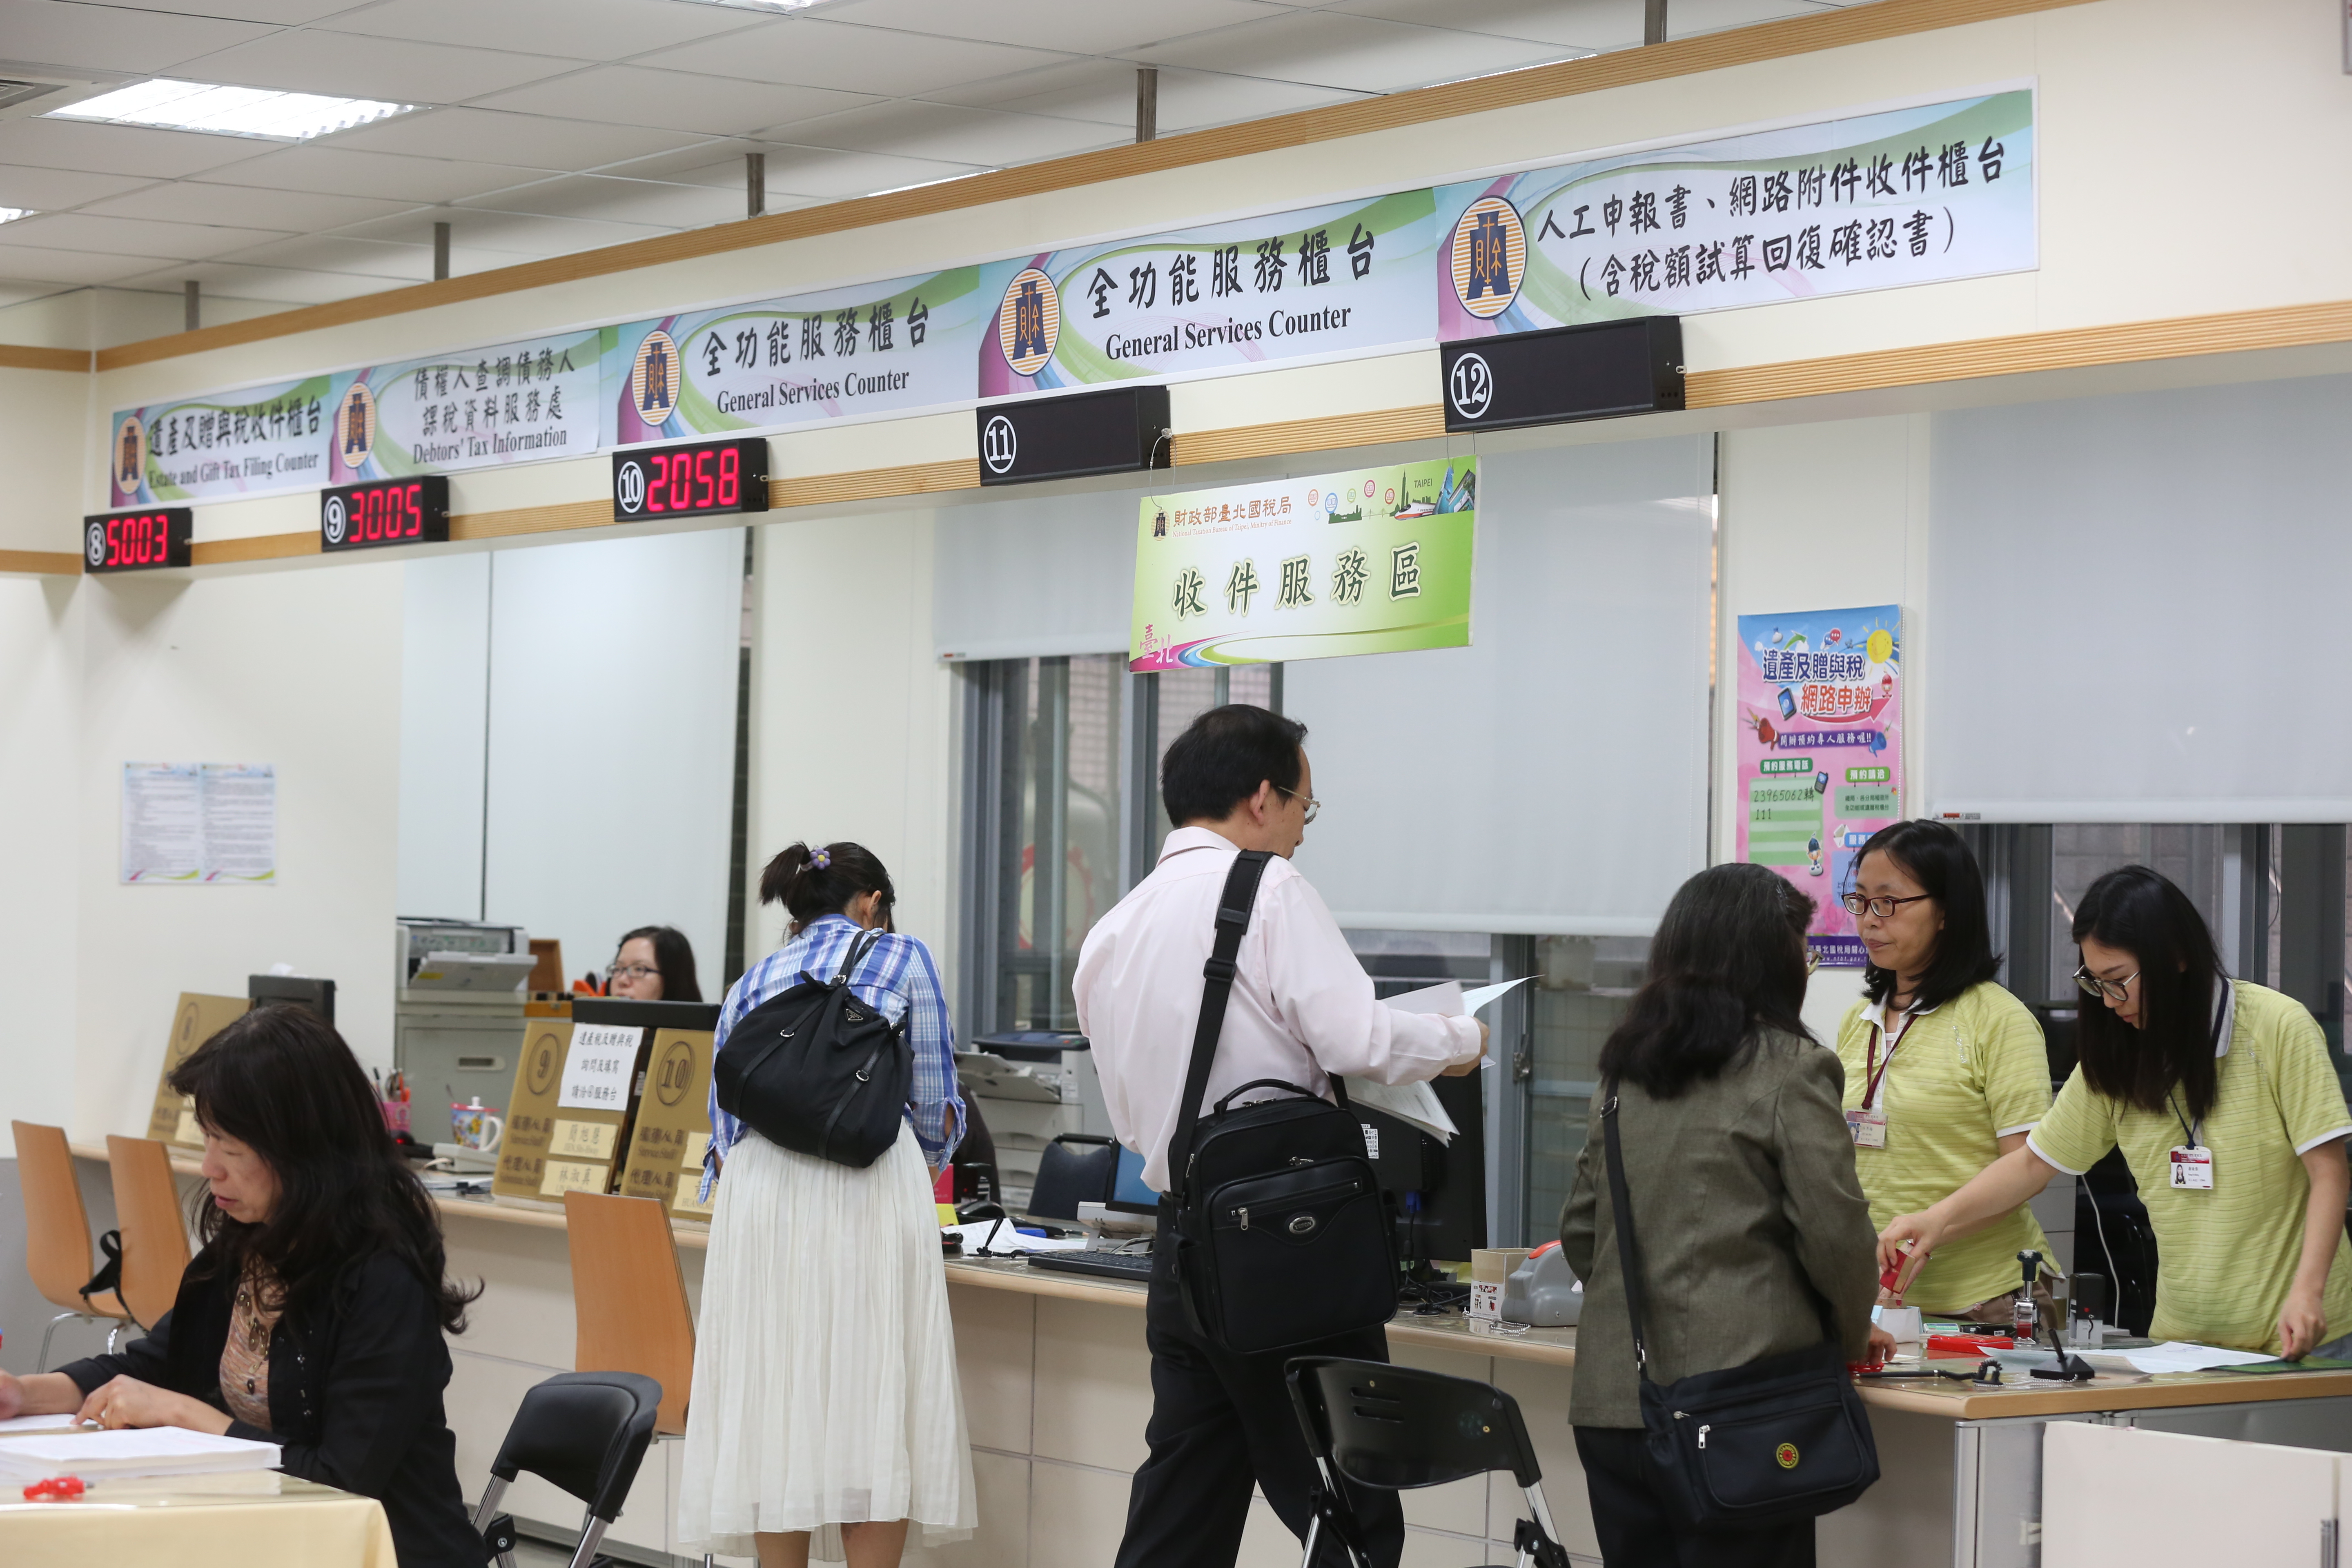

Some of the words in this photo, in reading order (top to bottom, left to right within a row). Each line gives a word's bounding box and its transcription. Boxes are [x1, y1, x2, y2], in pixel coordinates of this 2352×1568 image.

[1537, 136, 2005, 243] 人工申報書、網路附件收件櫃台
[1087, 222, 1375, 319] 全功能服務櫃台
[702, 296, 929, 376] 全功能服務櫃台
[1106, 325, 1178, 361] General
[1184, 316, 1262, 350] Services
[1268, 305, 1351, 338] Counter
[414, 348, 575, 401] 債權人查調債務人
[717, 384, 775, 414] General
[779, 378, 840, 406] Services
[845, 369, 909, 397] Counter
[1456, 364, 1489, 408] 12
[149, 394, 321, 457] 遺產及贈與稅收件櫃台
[423, 385, 563, 437] 課稅資料服務處
[413, 439, 464, 464] Debtors'
[468, 437, 488, 456] Tax
[493, 429, 567, 453] Information
[989, 424, 1011, 462] 11
[149, 468, 176, 488] Estate
[180, 468, 198, 484] and
[200, 458, 220, 483] Gift
[224, 460, 240, 479] Tax
[244, 456, 273, 479] Filing
[276, 453, 319, 472] Counter
[622, 468, 641, 504] 10
[647, 448, 739, 512] 2058
[1414, 478, 1433, 488] TAIPEI
[327, 504, 342, 536] 9
[349, 485, 421, 542] 3005
[1173, 496, 1292, 527] 財政部臺北國稅局
[1235, 523, 1250, 532] Taipei,
[1250, 521, 1267, 529] Minitry
[90, 527, 103, 563] 8
[107, 515, 168, 566] 5003
[1173, 542, 1421, 619] 收件服務區
[1763, 650, 1863, 681] 遺產及贈與稅
[1801, 684, 1871, 713] 網路申辦
[1754, 787, 1814, 804] 23965062轉
[662, 1059, 688, 1089] 10
